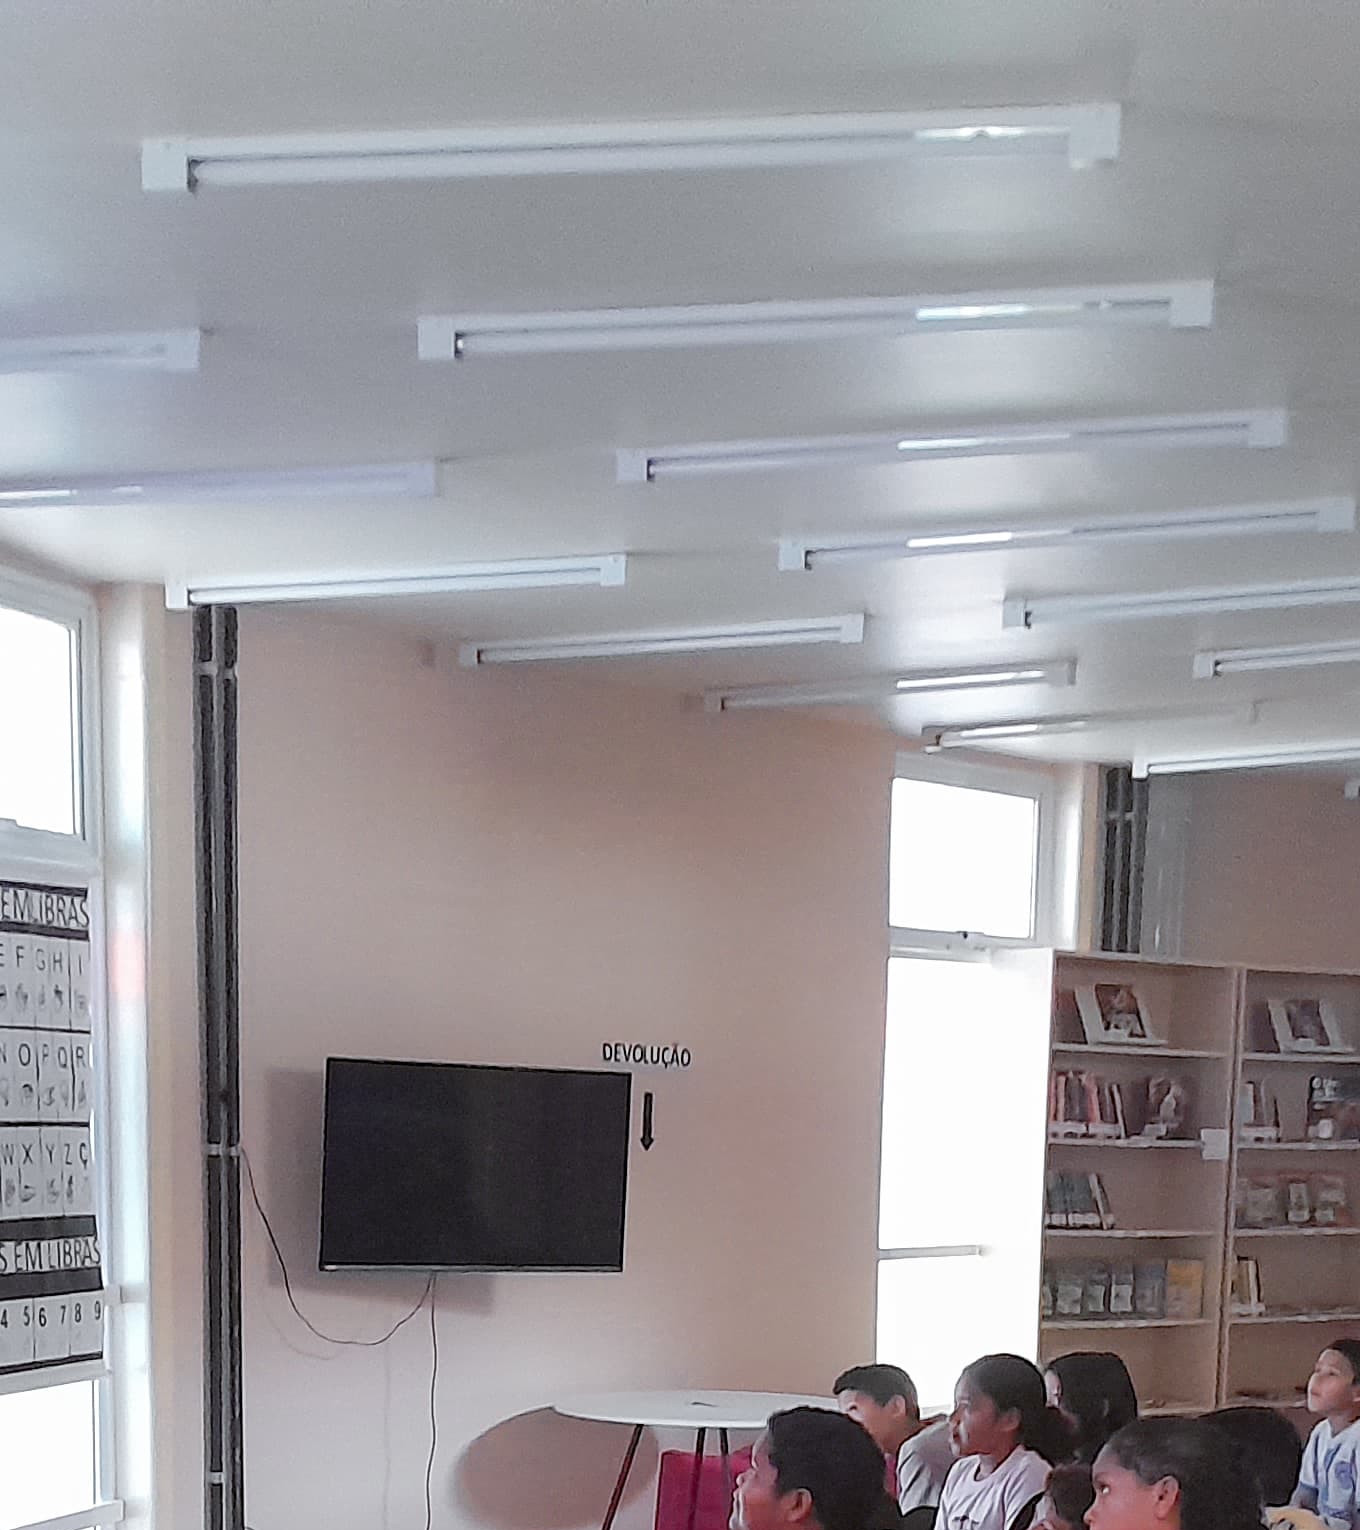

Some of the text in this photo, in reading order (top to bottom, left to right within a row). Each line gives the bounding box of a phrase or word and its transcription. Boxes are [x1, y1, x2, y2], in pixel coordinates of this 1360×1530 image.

[1, 888, 30, 920] EM
[15, 946, 25, 968] F
[52, 951, 63, 973] H
[18, 1043, 31, 1067] O
[57, 1046, 68, 1069] Q
[75, 1046, 87, 1068] R
[602, 1042, 692, 1069] DEVOLUÇÃO
[1, 1143, 14, 1165] W
[22, 1143, 33, 1165] X
[45, 1144, 55, 1165] Y
[64, 1143, 73, 1165] Z
[14, 1241, 43, 1272] EM
[48, 1235, 101, 1269] LIBRAS
[0, 1309, 9, 1329] 4
[23, 1305, 31, 1327] 5
[38, 1307, 48, 1328] 6
[59, 1305, 67, 1324] 7
[74, 1302, 82, 1323] 8
[94, 1300, 102, 1320] 9
